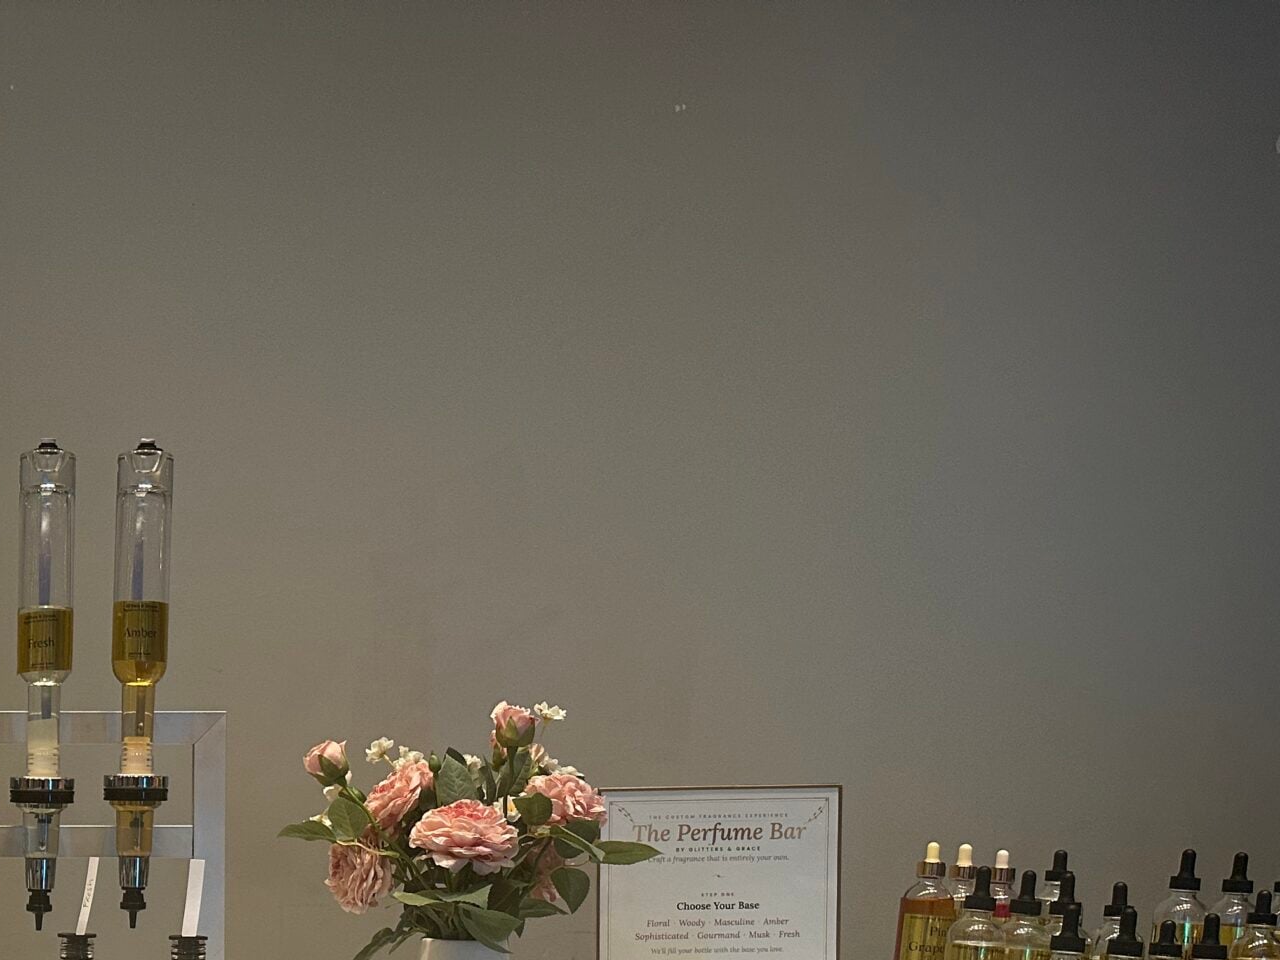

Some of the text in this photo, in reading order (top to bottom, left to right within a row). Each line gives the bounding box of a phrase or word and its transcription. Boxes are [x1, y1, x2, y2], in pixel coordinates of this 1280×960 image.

[123, 627, 157, 638] Amber
[28, 636, 55, 648] Fresh
[632, 822, 807, 845] The Perfume Bar
[677, 902, 711, 910] Choose
[738, 901, 760, 909] Base
[647, 917, 789, 928] Floral Woody Masculine Amber
[635, 932, 689, 942] Sophisticated
[697, 931, 740, 939] Gourmand
[779, 930, 800, 938] Fresh
[930, 926, 950, 937] Pin
